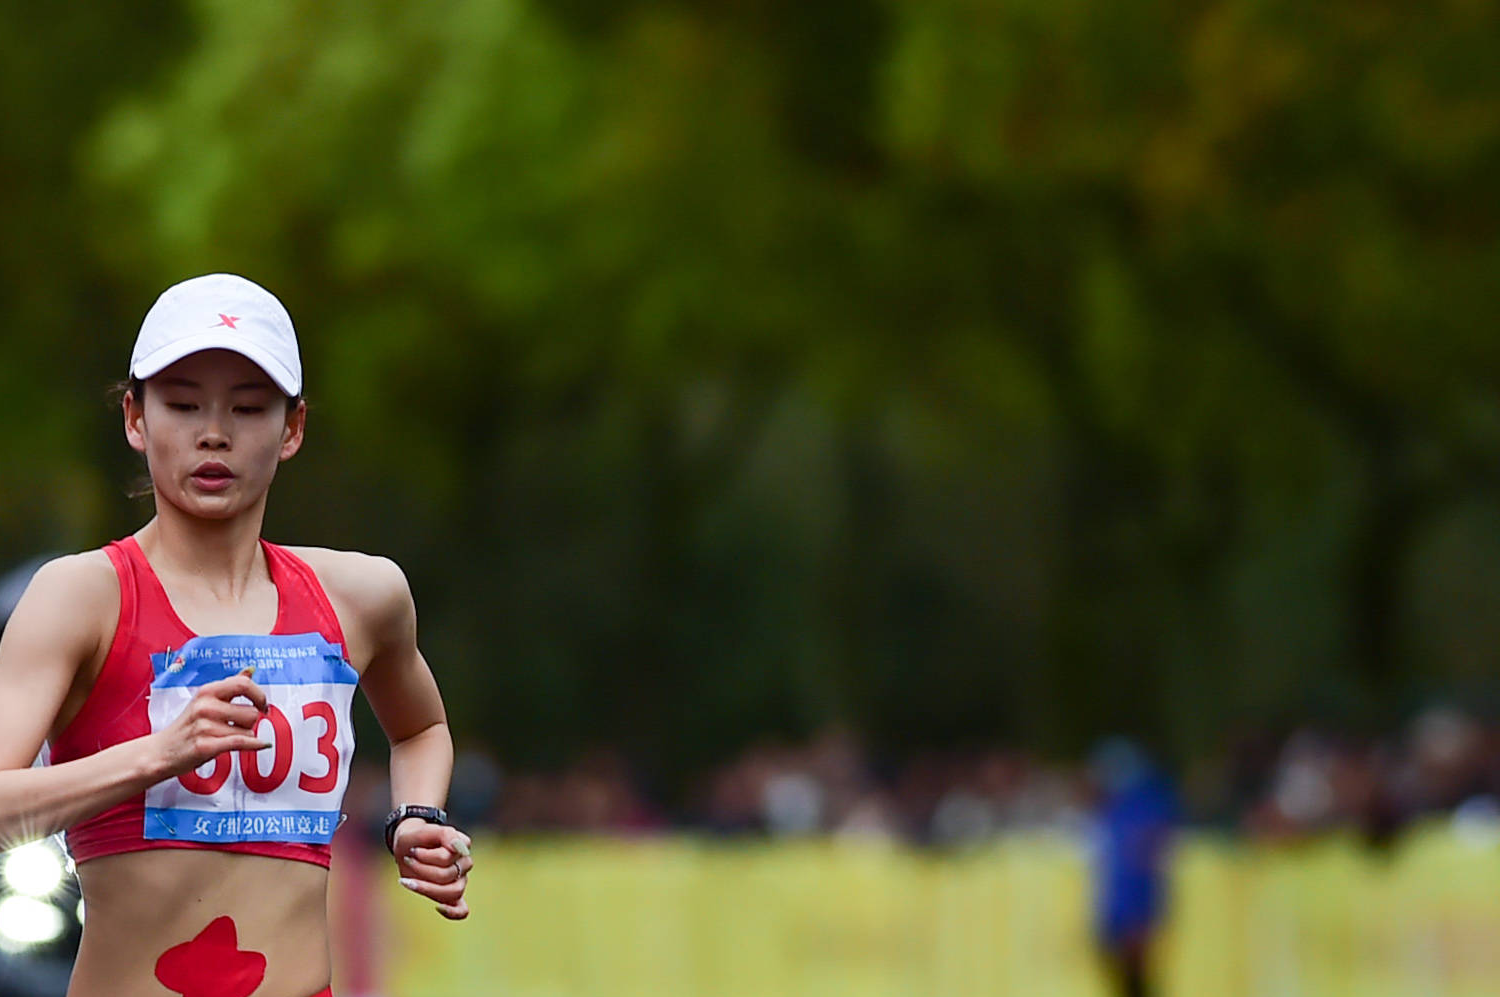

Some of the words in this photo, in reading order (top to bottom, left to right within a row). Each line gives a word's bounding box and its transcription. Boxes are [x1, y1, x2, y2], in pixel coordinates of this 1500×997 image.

[192, 815, 330, 837] 女子组20公里竞走
